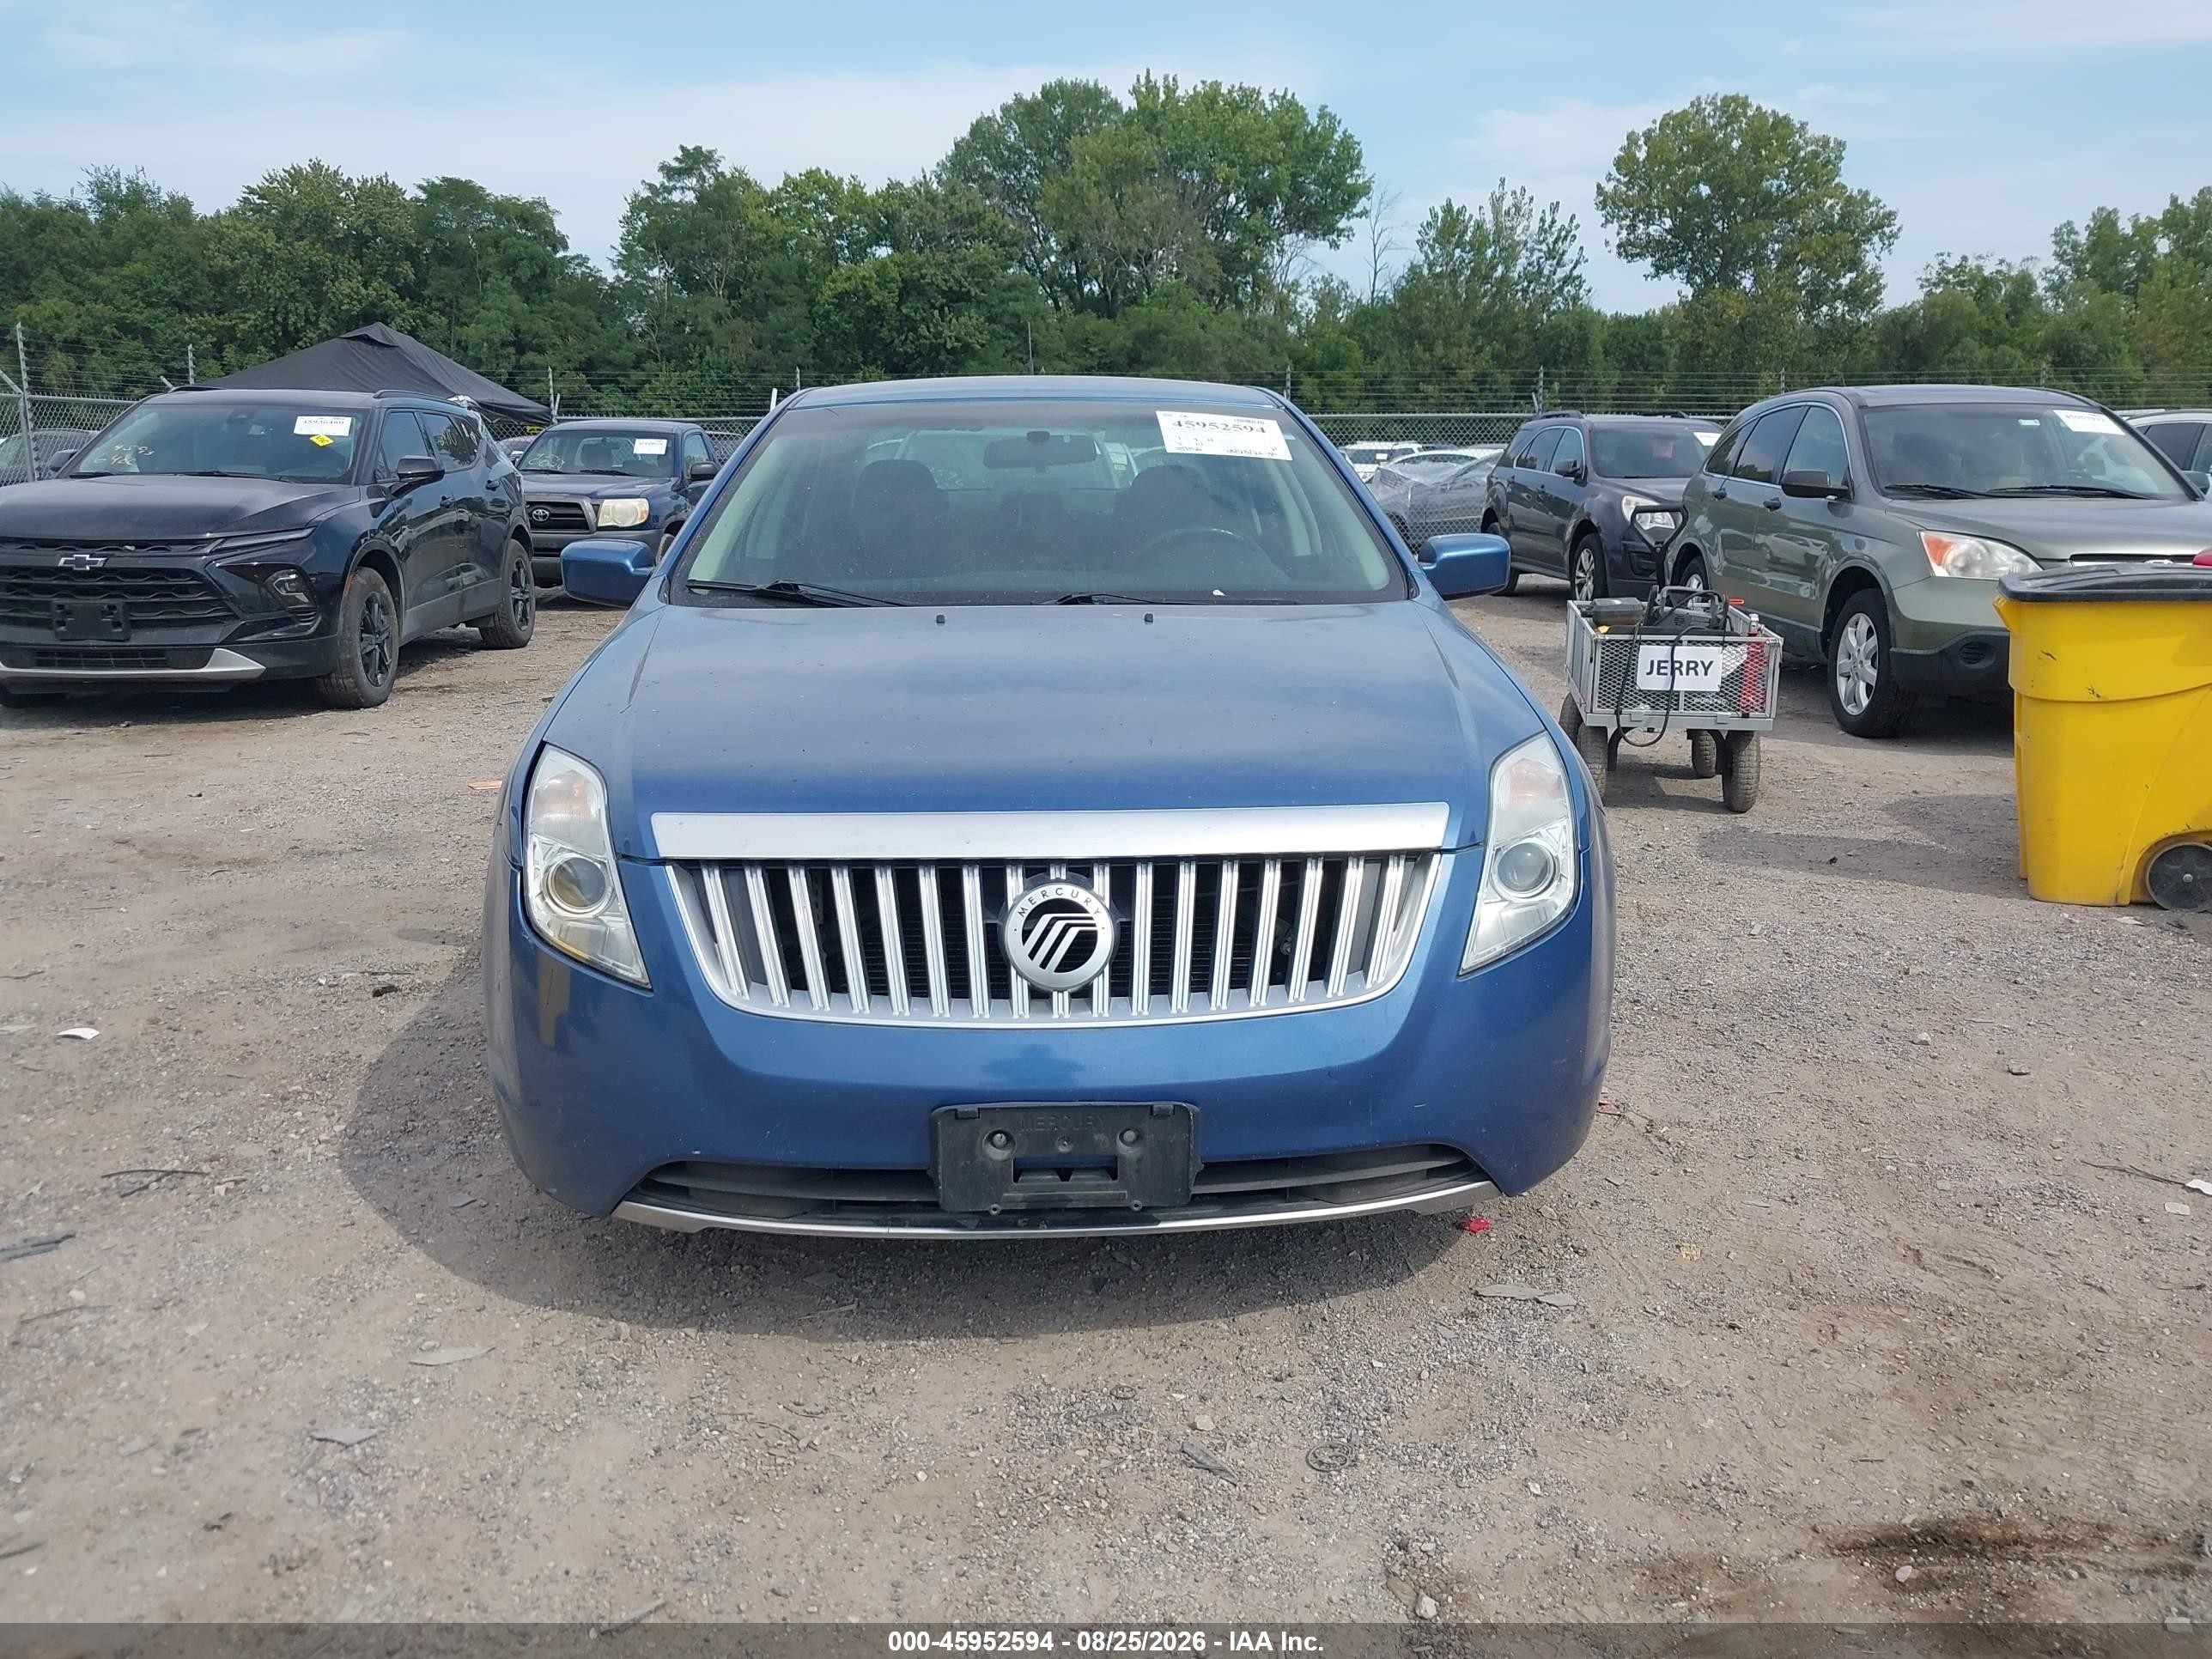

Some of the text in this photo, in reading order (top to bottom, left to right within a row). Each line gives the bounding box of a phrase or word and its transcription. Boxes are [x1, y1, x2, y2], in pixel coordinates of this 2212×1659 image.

[1171, 419, 1267, 434] 45952594
[1645, 659, 1714, 677] JERRY
[1017, 887, 1103, 918] MERCURY
